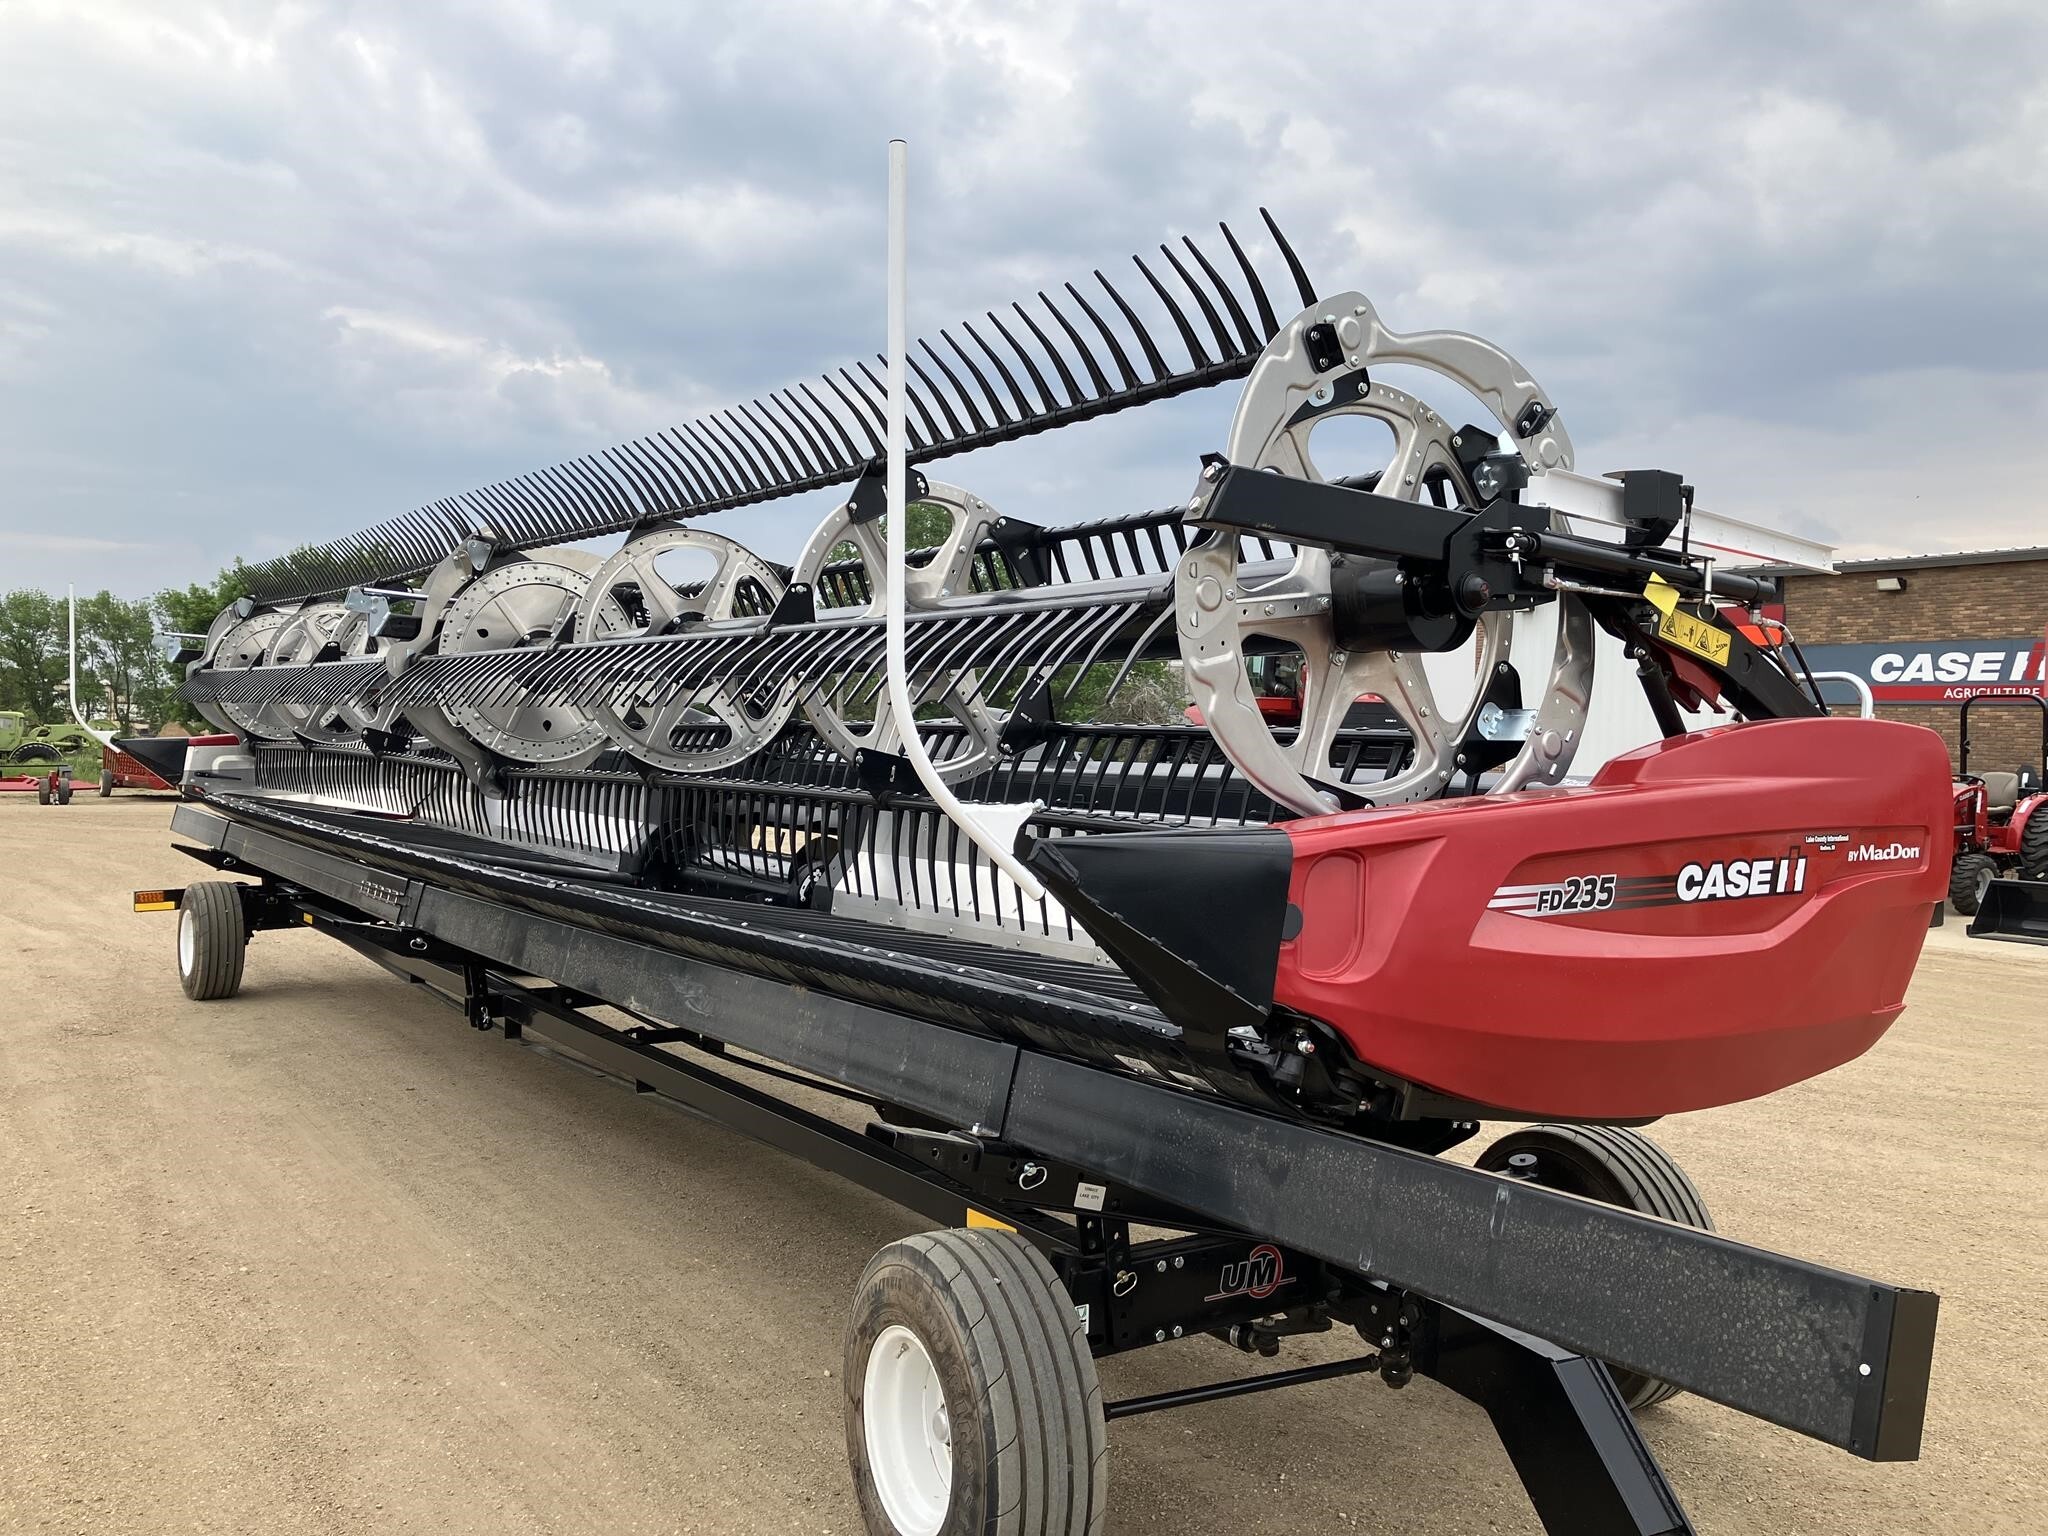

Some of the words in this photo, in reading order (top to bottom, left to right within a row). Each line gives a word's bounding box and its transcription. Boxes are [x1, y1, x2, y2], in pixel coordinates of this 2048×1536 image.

[1870, 652, 2006, 682] CASE
[1847, 850, 1859, 862] BY
[1860, 843, 1920, 861] MacDon
[1676, 859, 1773, 901] CASE
[1220, 1254, 1277, 1295] UM
